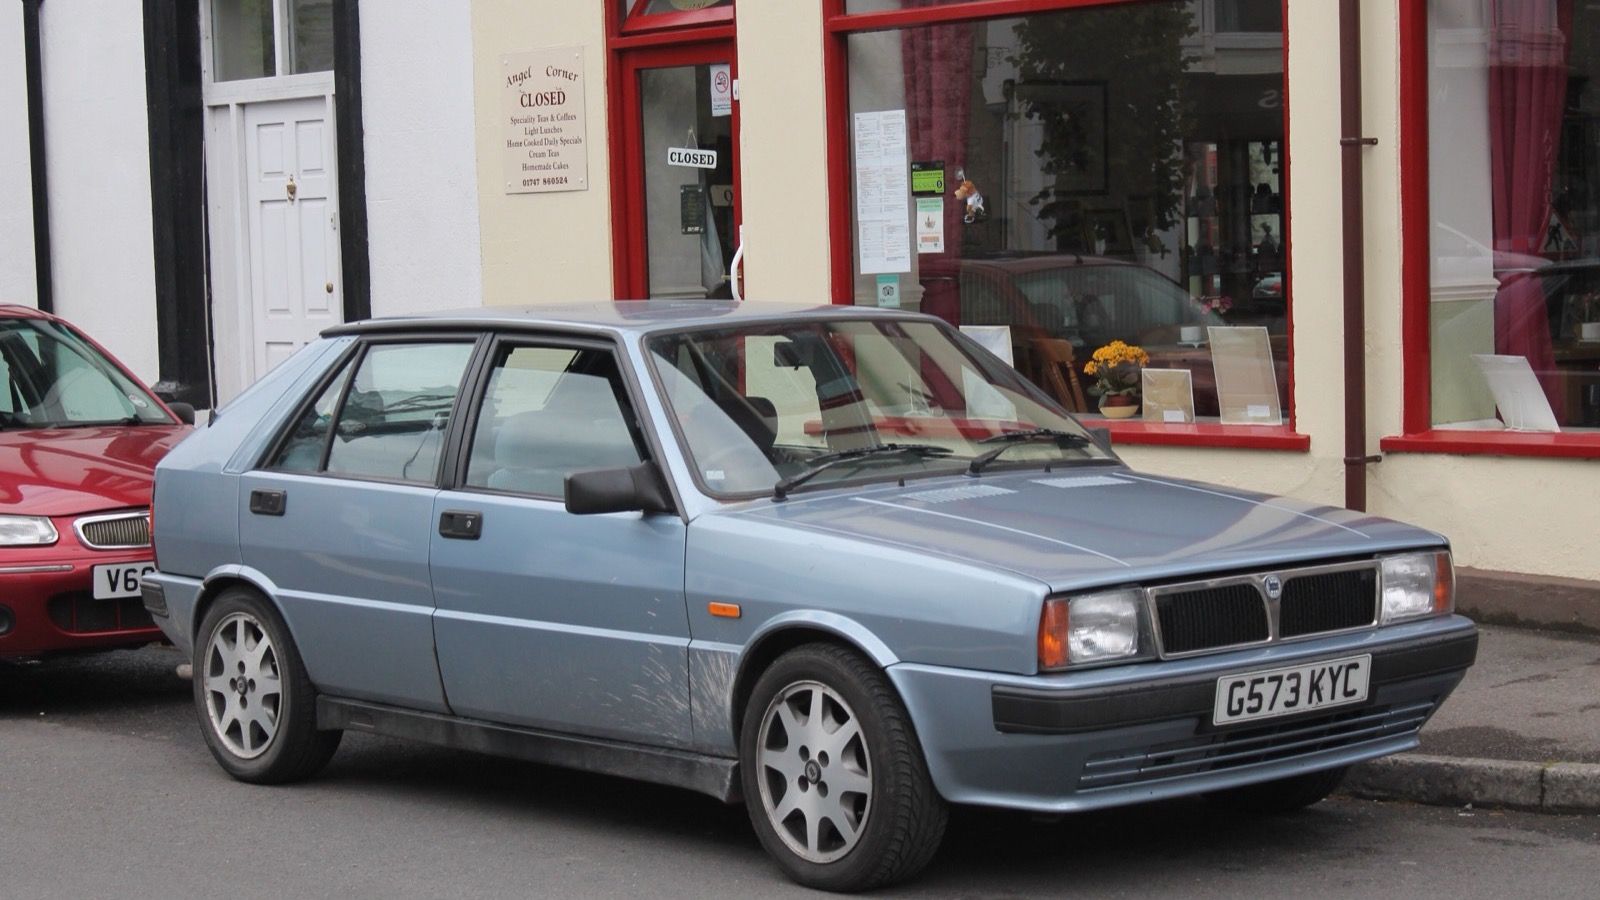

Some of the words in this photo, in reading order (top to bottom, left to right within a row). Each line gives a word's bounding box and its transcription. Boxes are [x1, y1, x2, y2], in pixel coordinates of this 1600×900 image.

[506, 66, 532, 88] Angel
[546, 65, 578, 82] Corner
[520, 91, 566, 108] CLOSED
[510, 115, 535, 125] Speciality
[537, 114, 549, 123] Teas
[556, 112, 577, 121] Coffees
[524, 127, 539, 136] Light
[540, 126, 563, 135] Lunches
[507, 140, 523, 148] Home
[523, 139, 543, 147] Cooked
[544, 138, 559, 147] Daily
[560, 136, 582, 146] Specials
[529, 150, 546, 159] Cream
[548, 149, 560, 158] Teas
[670, 152, 715, 165] CLOSED
[522, 162, 551, 171] Homemade
[552, 161, 569, 170] Cakes
[522, 178, 540, 187] 01747
[1227, 672, 1301, 717] G573
[1307, 662, 1360, 704] KYC
